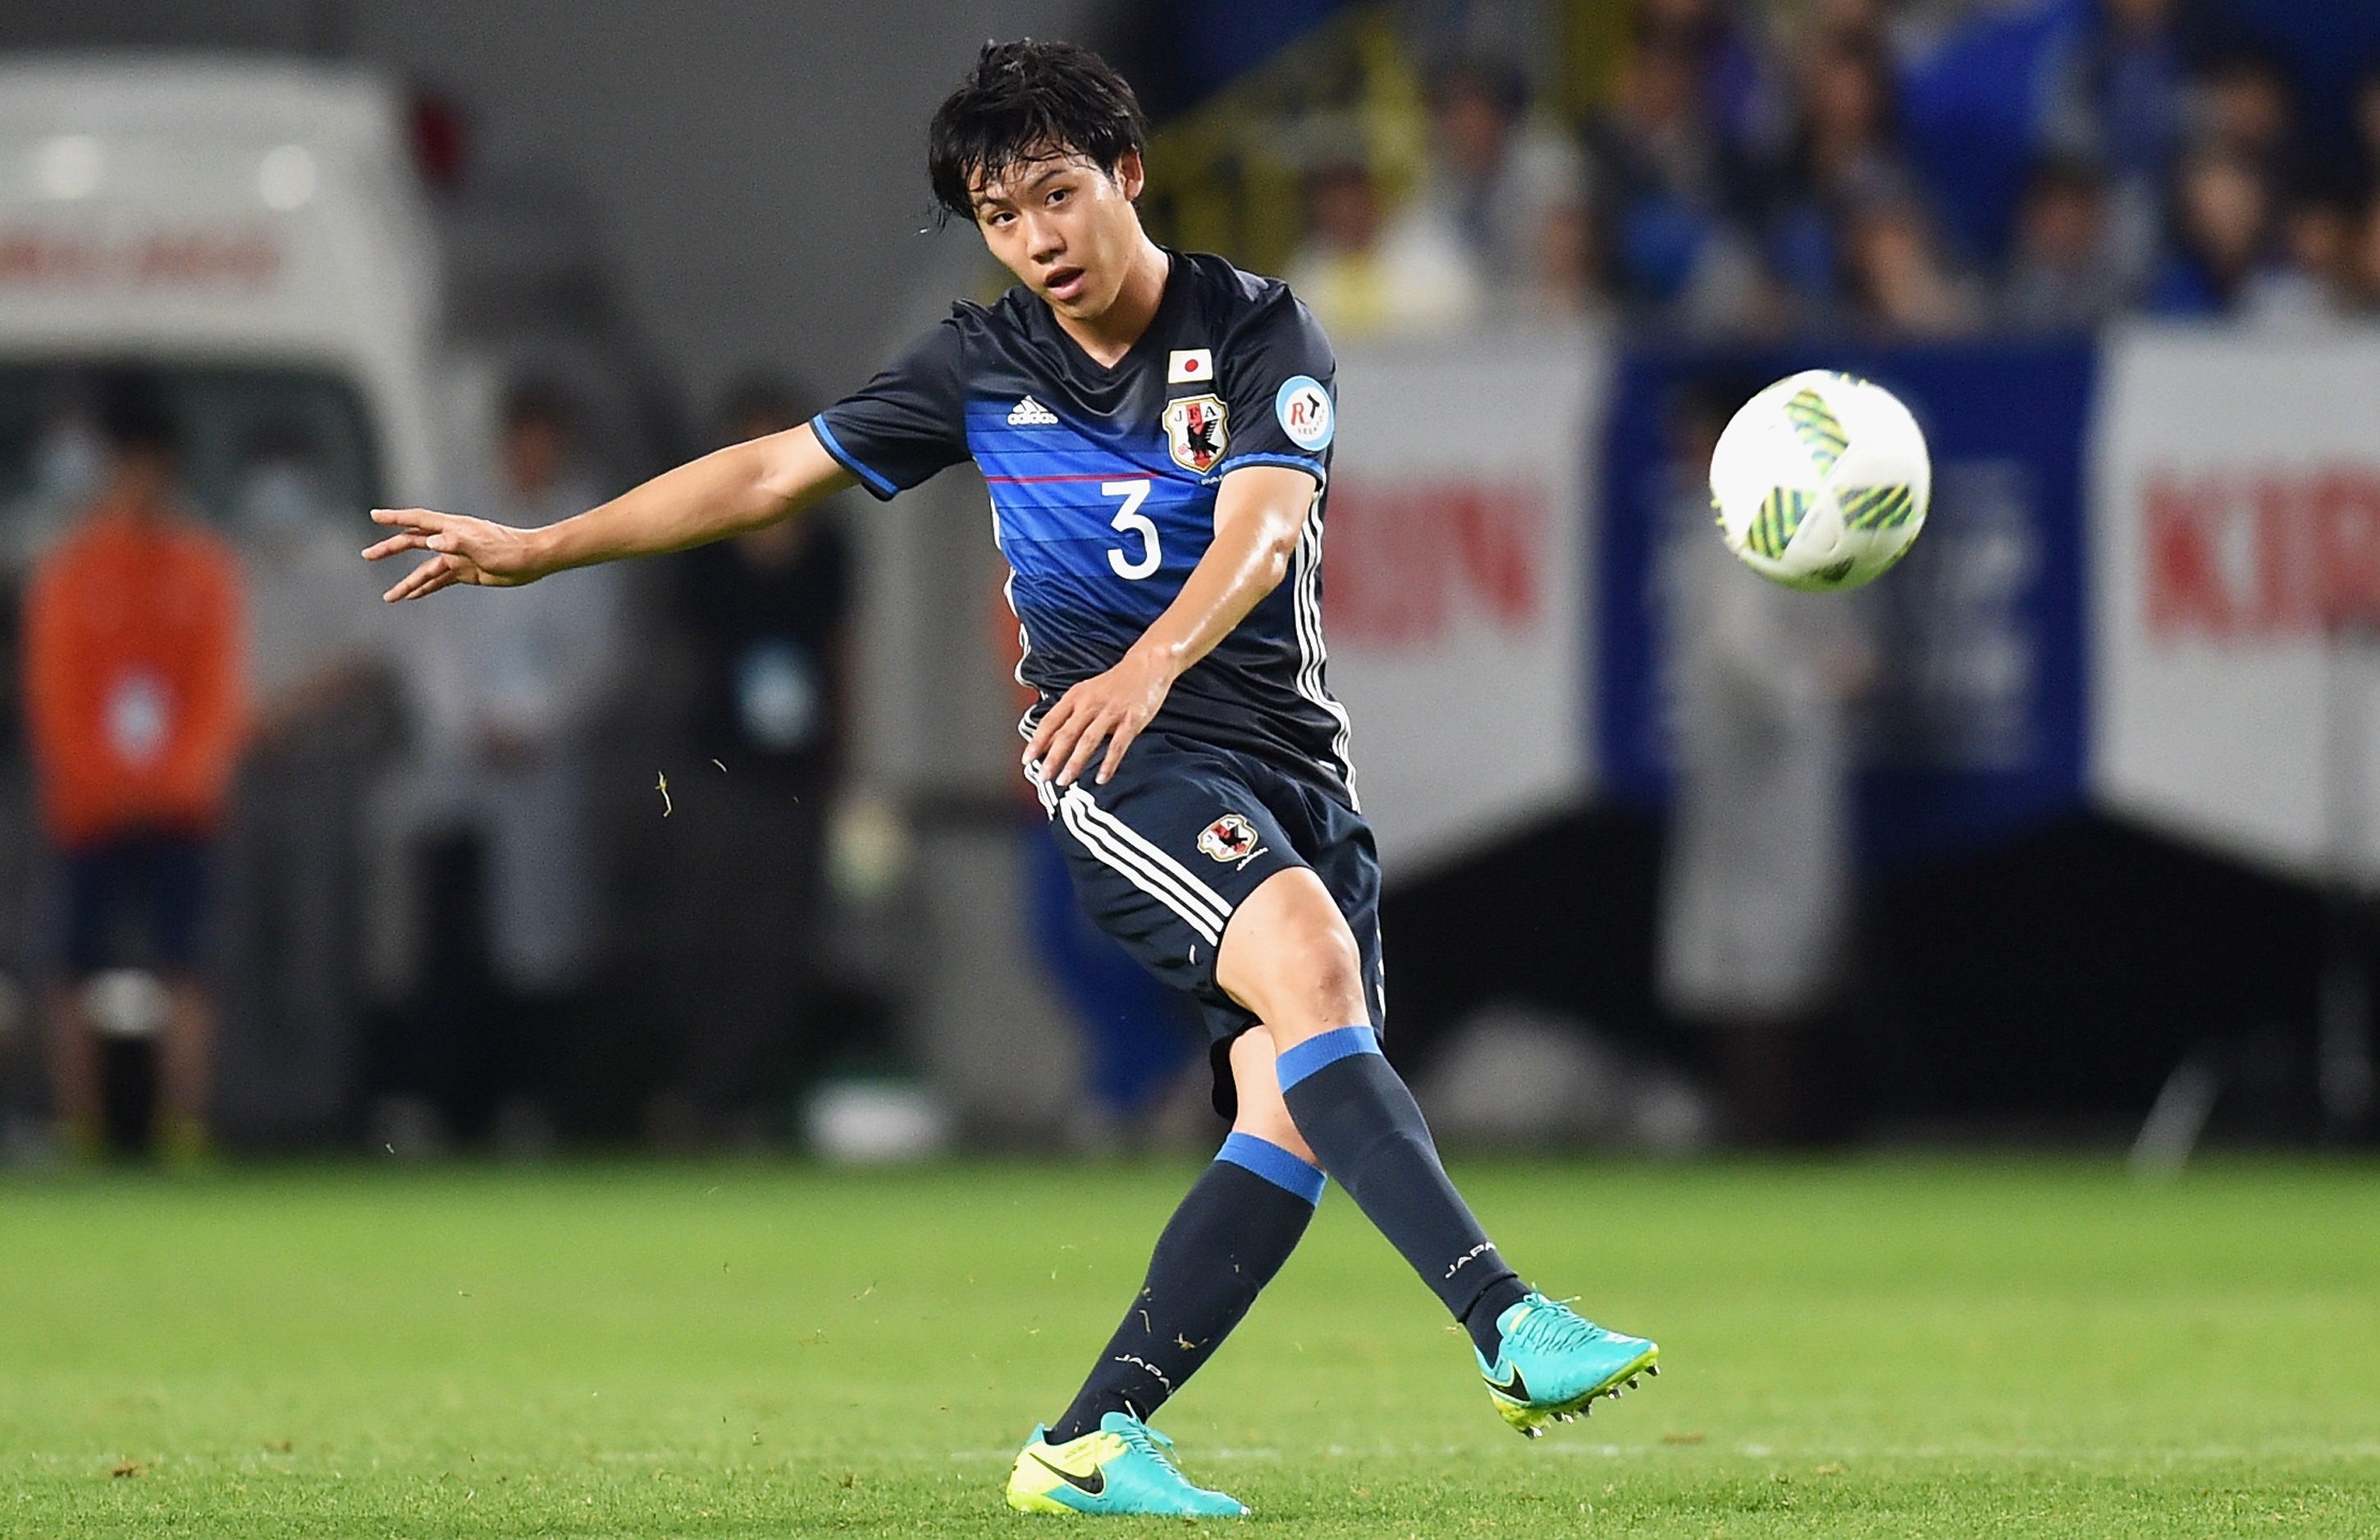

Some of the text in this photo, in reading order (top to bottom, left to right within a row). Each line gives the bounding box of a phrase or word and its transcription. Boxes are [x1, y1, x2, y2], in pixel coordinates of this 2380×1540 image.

[1174, 405, 1217, 422] JFA
[1102, 479, 1162, 580] 3
[1115, 1354, 1173, 1395] JAPA
